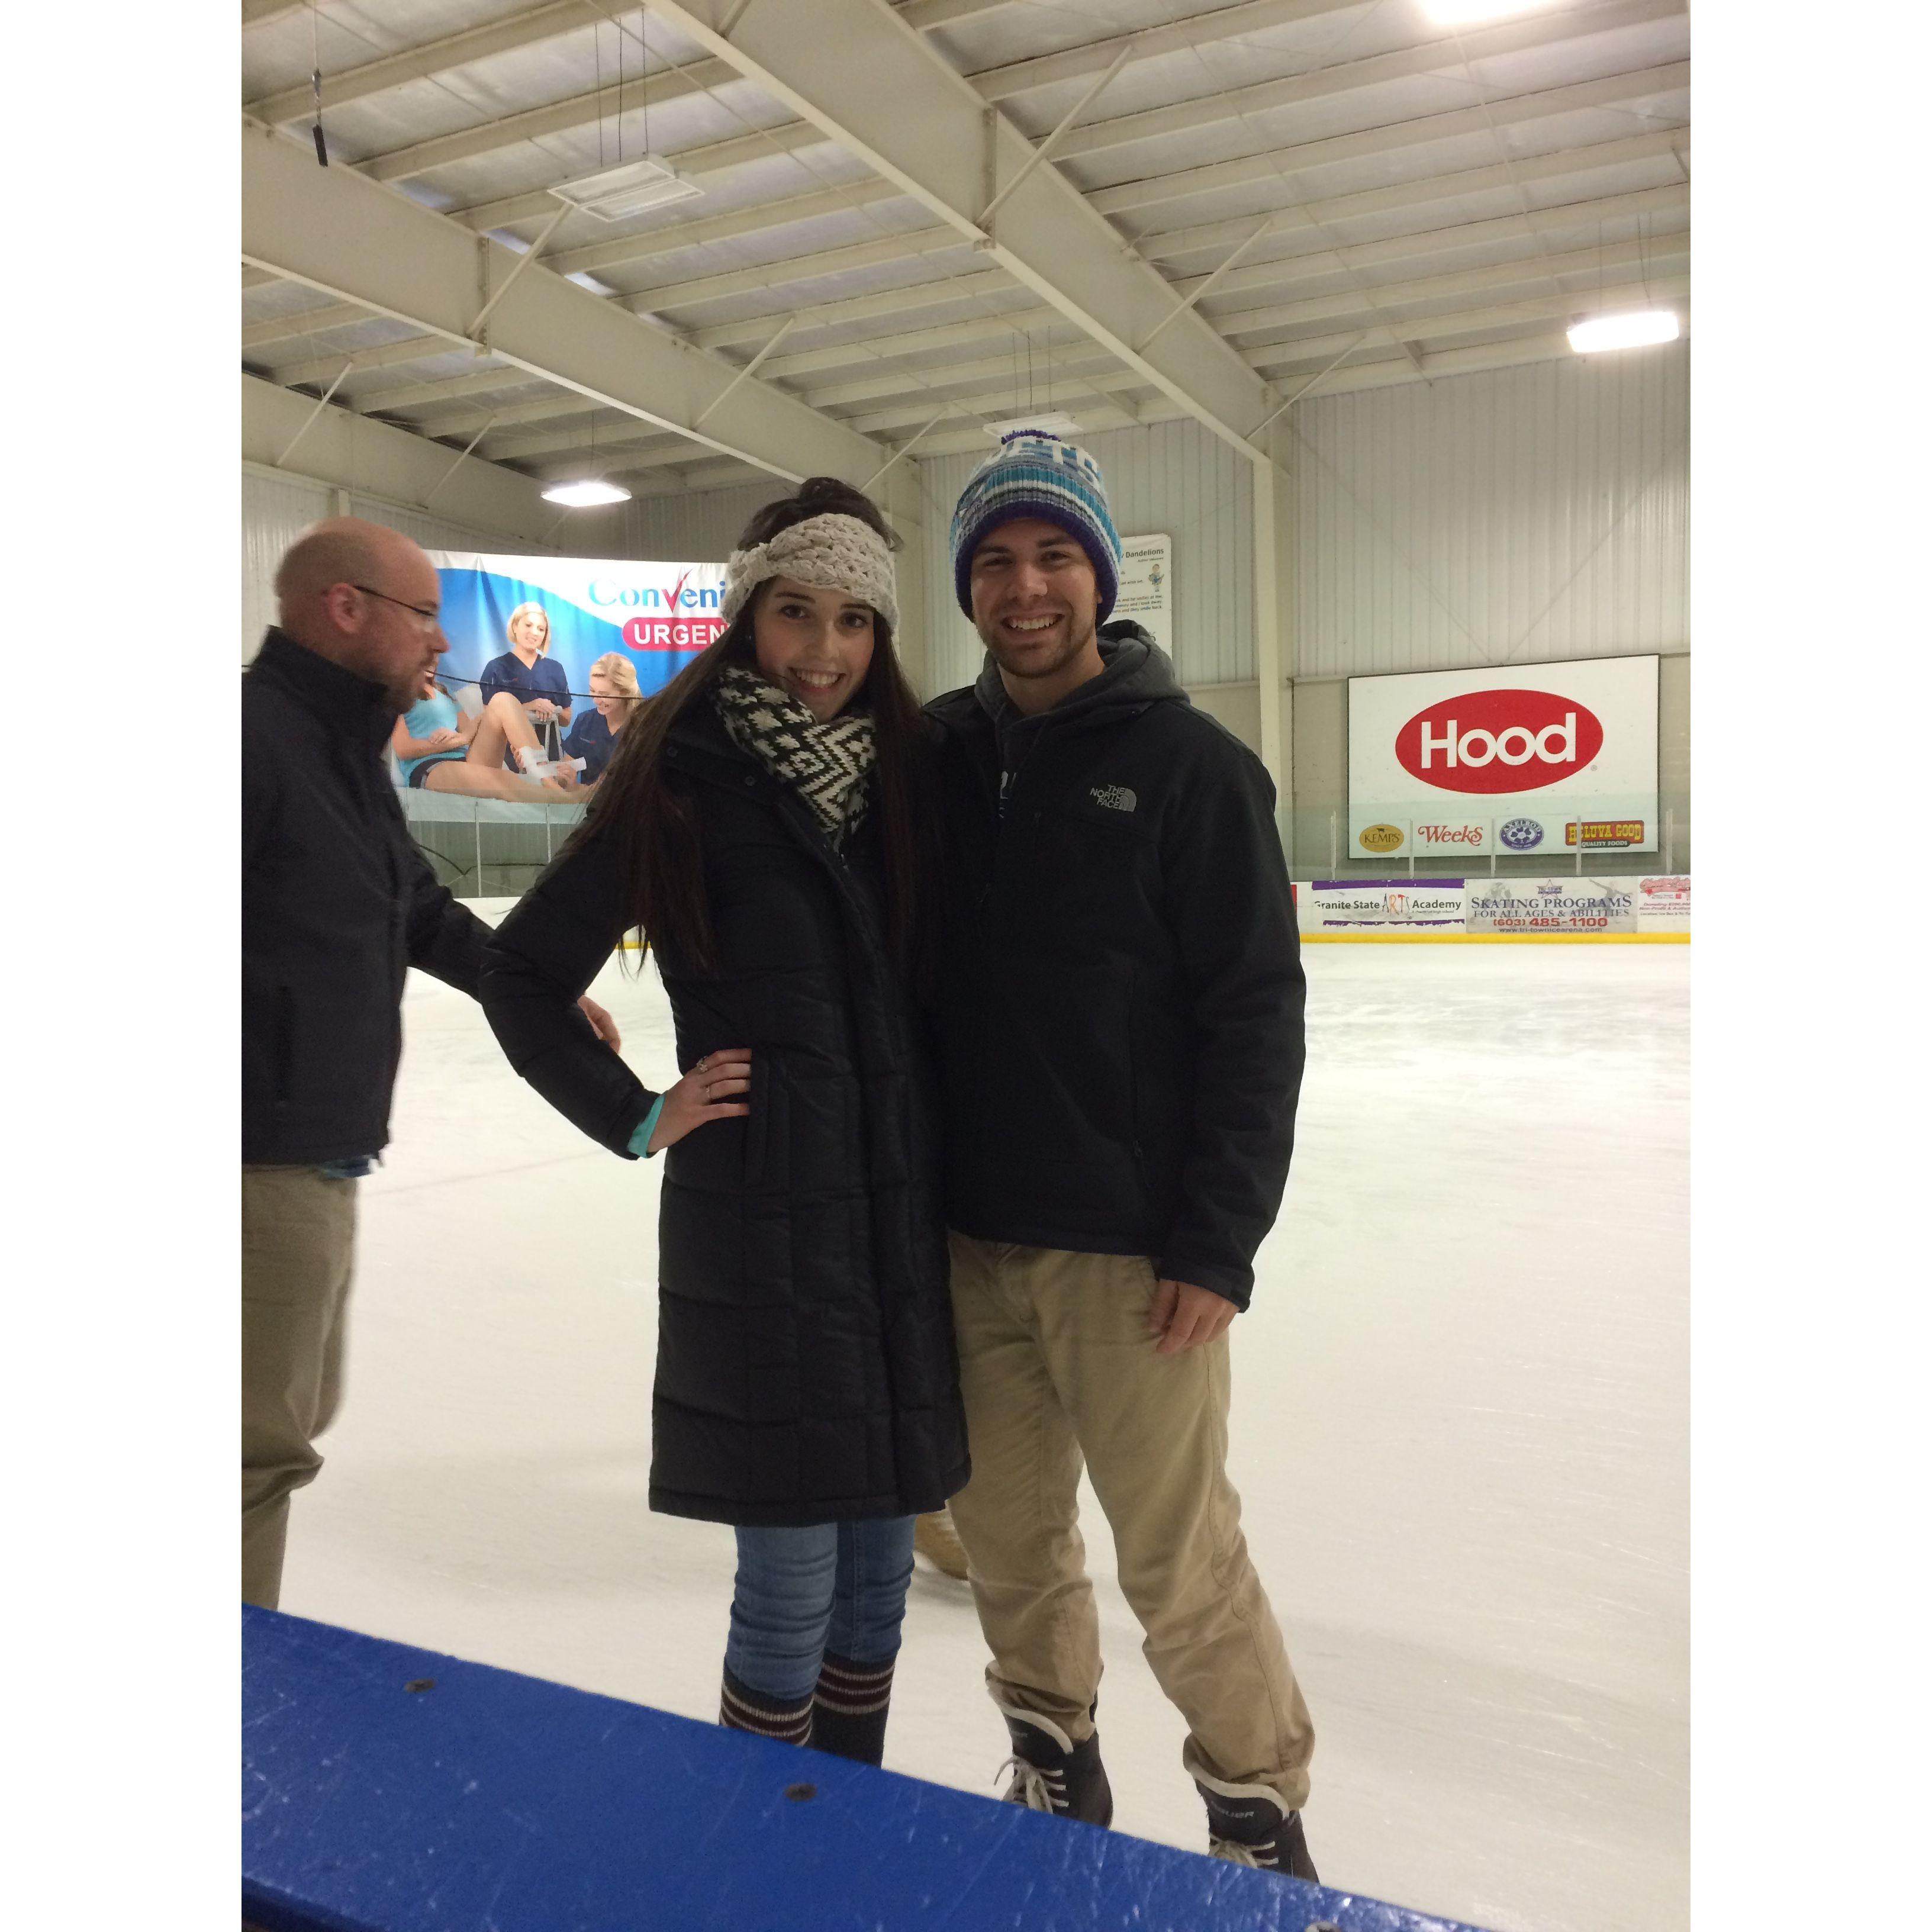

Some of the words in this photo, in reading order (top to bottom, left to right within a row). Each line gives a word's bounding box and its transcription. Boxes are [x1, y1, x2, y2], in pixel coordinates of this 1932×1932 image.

[1126, 549, 1164, 558] Dandelions
[588, 568, 726, 613] Conveni
[634, 624, 728, 645] URGEN
[1421, 712, 1576, 768] Hood
[1090, 787, 1120, 802] NORTH
[1107, 784, 1125, 795] THE
[1097, 797, 1120, 809] FACE
[1364, 833, 1399, 843] KEMPS
[1418, 825, 1483, 846] Weeks
[1616, 824, 1642, 840] GOOD
[1354, 900, 1380, 909] State
[1382, 893, 1411, 915] ARTS
[1412, 899, 1462, 910] Academy
[1471, 897, 1539, 909] SKATING
[1544, 895, 1632, 909] PROGRAMS
[1474, 910, 1497, 918] FOR
[1500, 910, 1522, 918] ALL
[1525, 909, 1554, 917] AGES
[1557, 909, 1566, 917] &
[1570, 909, 1630, 917] ABILITIES
[1529, 917, 1608, 927] 485-1100
[1210, 1800, 1255, 1818] UER
